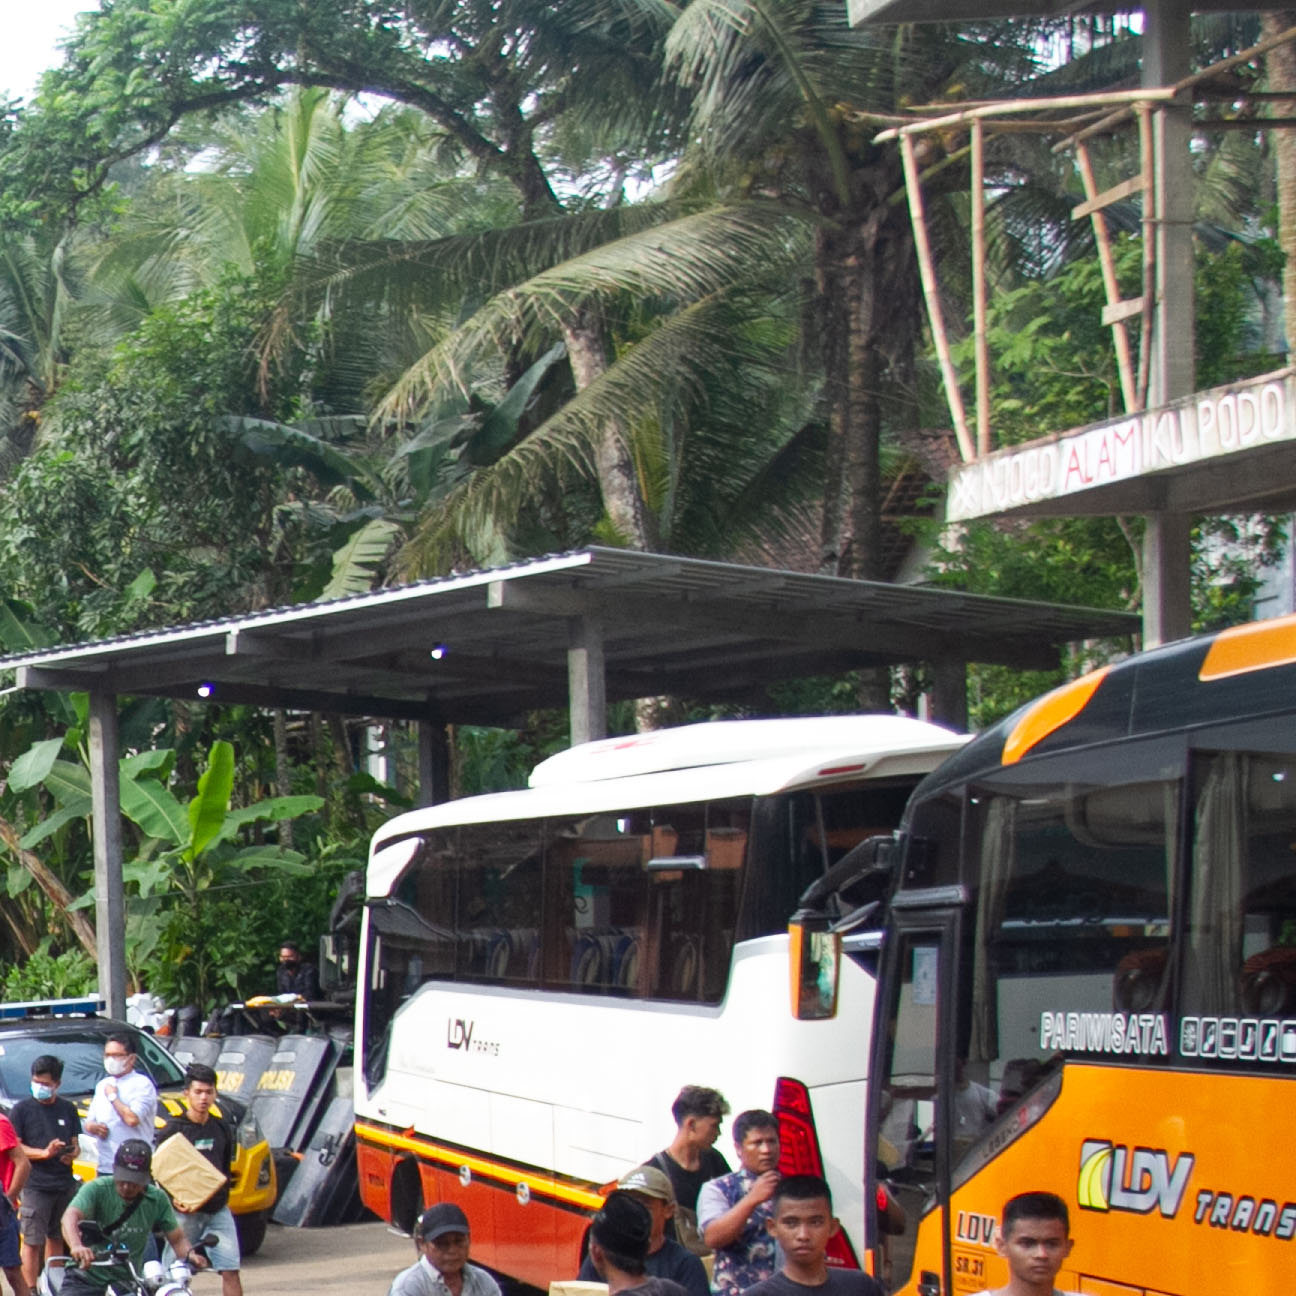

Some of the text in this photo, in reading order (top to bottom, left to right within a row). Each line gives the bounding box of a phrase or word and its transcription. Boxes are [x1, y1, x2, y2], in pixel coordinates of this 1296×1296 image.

[1064, 425, 1137, 490] ALAM
[1197, 382, 1285, 456] PODO
[447, 1018, 474, 1052] LDV
[1040, 1011, 1168, 1055] PARIWISATA
[1109, 1145, 1296, 1241] LDV TRANS
[956, 1210, 996, 1247] LDV
